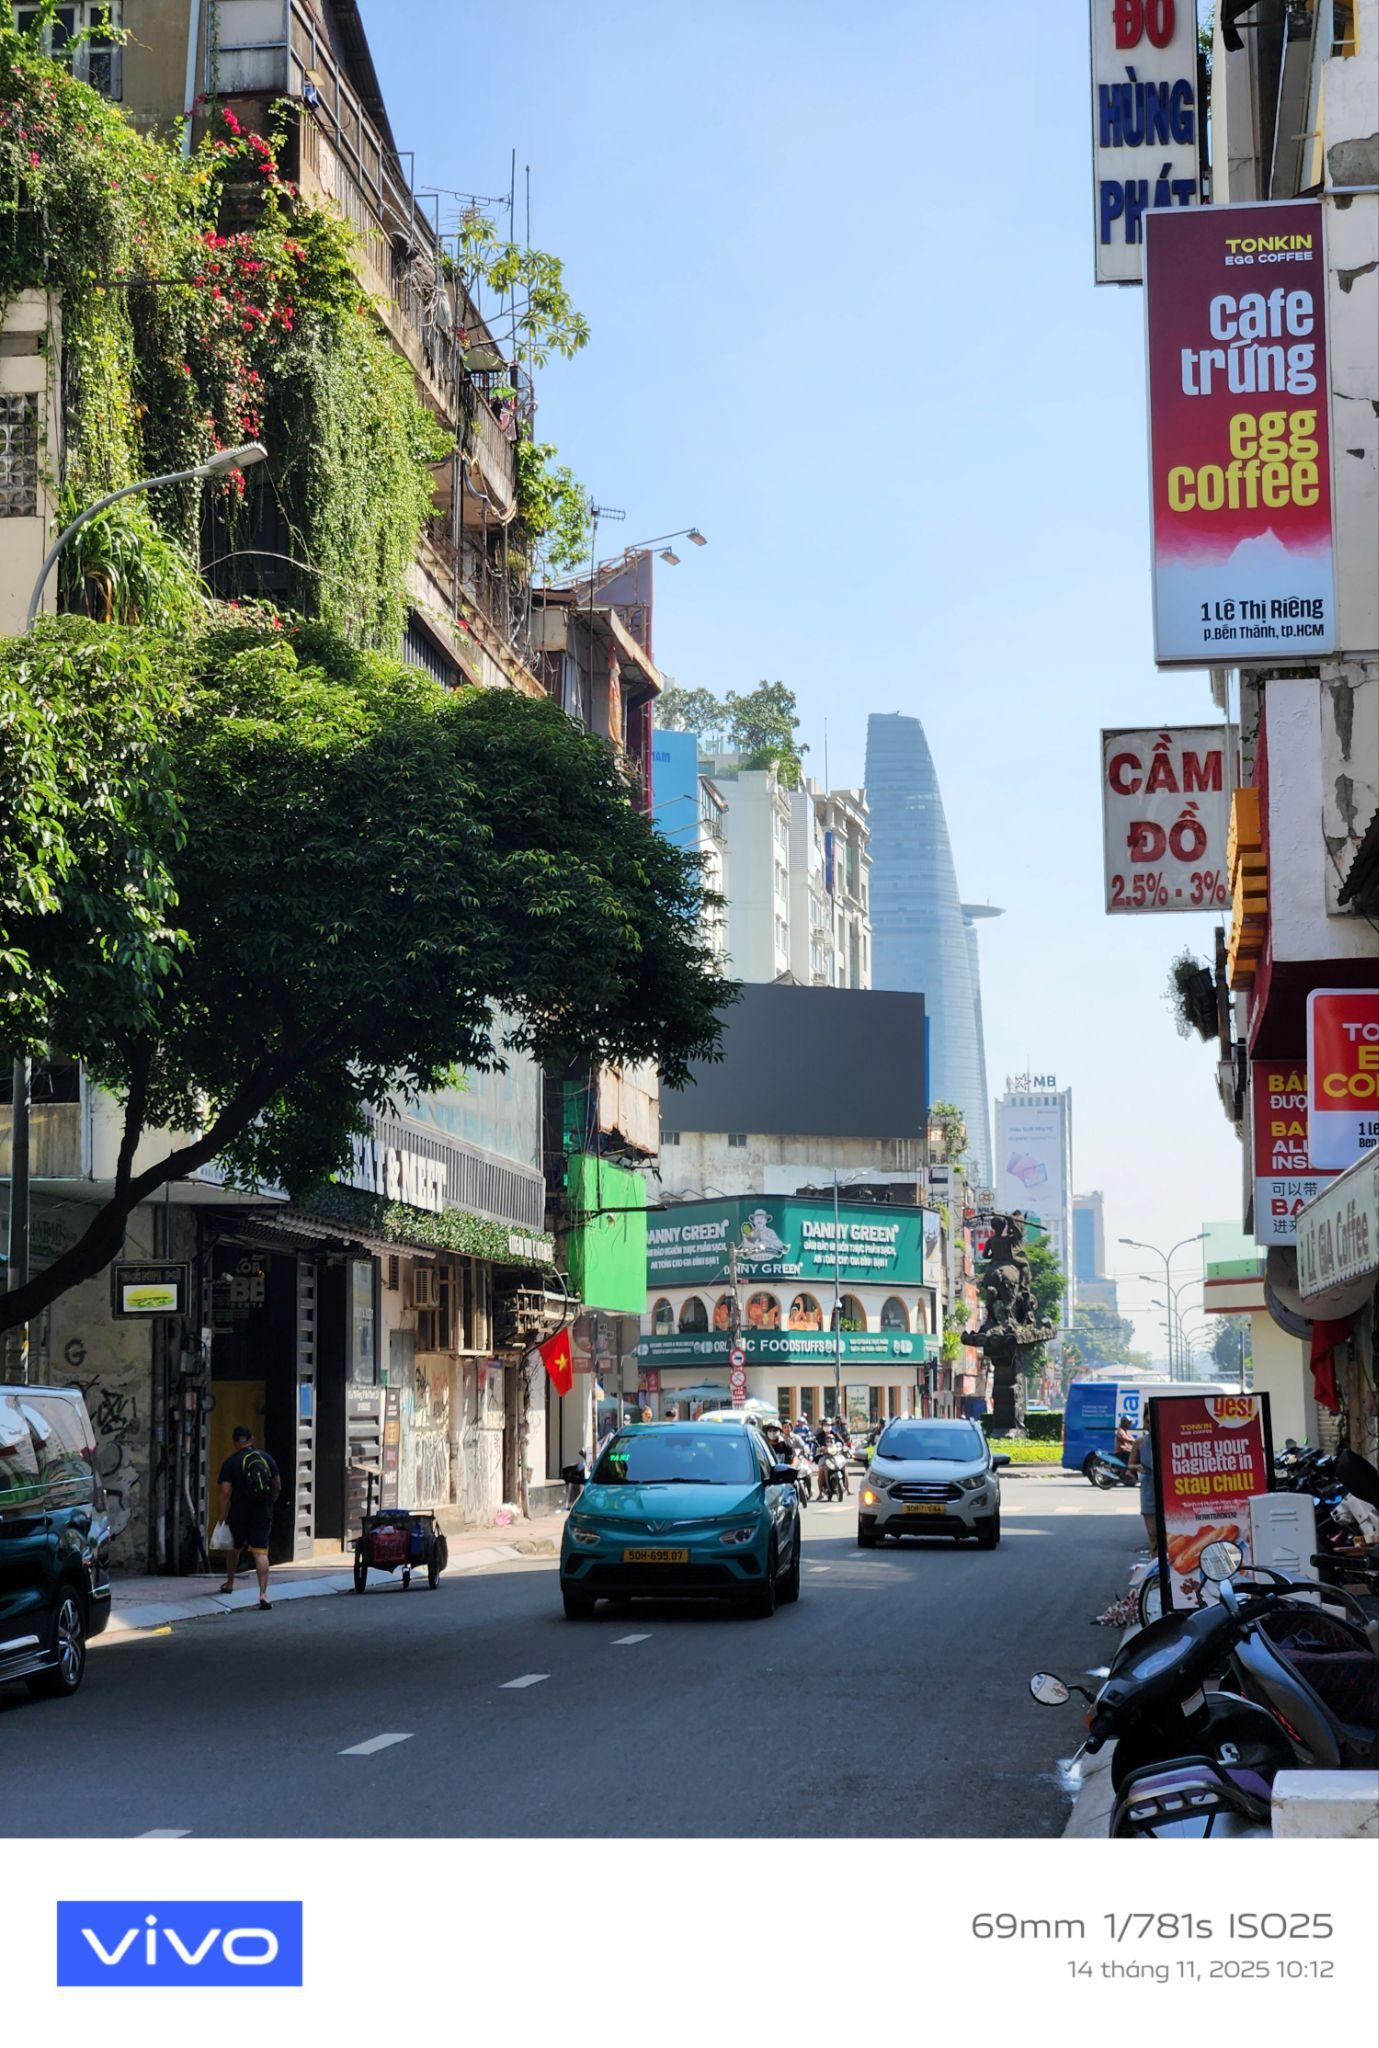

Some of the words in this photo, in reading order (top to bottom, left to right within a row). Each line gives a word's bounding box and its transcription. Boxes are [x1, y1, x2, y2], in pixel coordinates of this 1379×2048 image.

[1098, 65, 1194, 147] HÙNG
[1225, 234, 1313, 254] TONKIN
[1225, 255, 1254, 266] EGG
[1258, 252, 1313, 263] COFFEE
[1209, 288, 1314, 341] cafe
[1181, 338, 1317, 396] trứng
[1229, 409, 1319, 462] egg
[1167, 459, 1319, 512] coffee
[1201, 602, 1211, 621] 1
[1239, 600, 1266, 623] Thị
[1271, 595, 1324, 619] Riêng
[1281, 623, 1324, 640] tp.HCM
[1108, 734, 1223, 796] CẦM
[1127, 801, 1207, 863] ĐỒ
[1111, 871, 1168, 907] 2.5%
[1190, 869, 1227, 905] 3%
[1033, 1075, 1057, 1088] MB
[1268, 1070, 1308, 1092] BÁ
[1323, 1072, 1378, 1098] CO
[1271, 1121, 1308, 1137] BA
[1272, 1155, 1310, 1170] INS
[647, 1226, 681, 1245] ANNY
[682, 1221, 726, 1242] GREEN
[802, 1220, 850, 1239] DANNY
[850, 1224, 896, 1242] GREEN
[1335, 1198, 1369, 1268] Coffee
[723, 1262, 759, 1275] DNNY
[761, 1263, 800, 1275] GREEN
[760, 1340, 824, 1354] FOODSTUFFS
[1213, 1397, 1255, 1421] yes!
[1171, 1441, 1213, 1458] bring
[1213, 1438, 1249, 1456] your
[1172, 1454, 1237, 1475] baguette
[1239, 1454, 1253, 1470] in
[1174, 1476, 1211, 1495] stay
[1212, 1472, 1255, 1492] chill!
[628, 1551, 683, 1562] 50H-695.07
